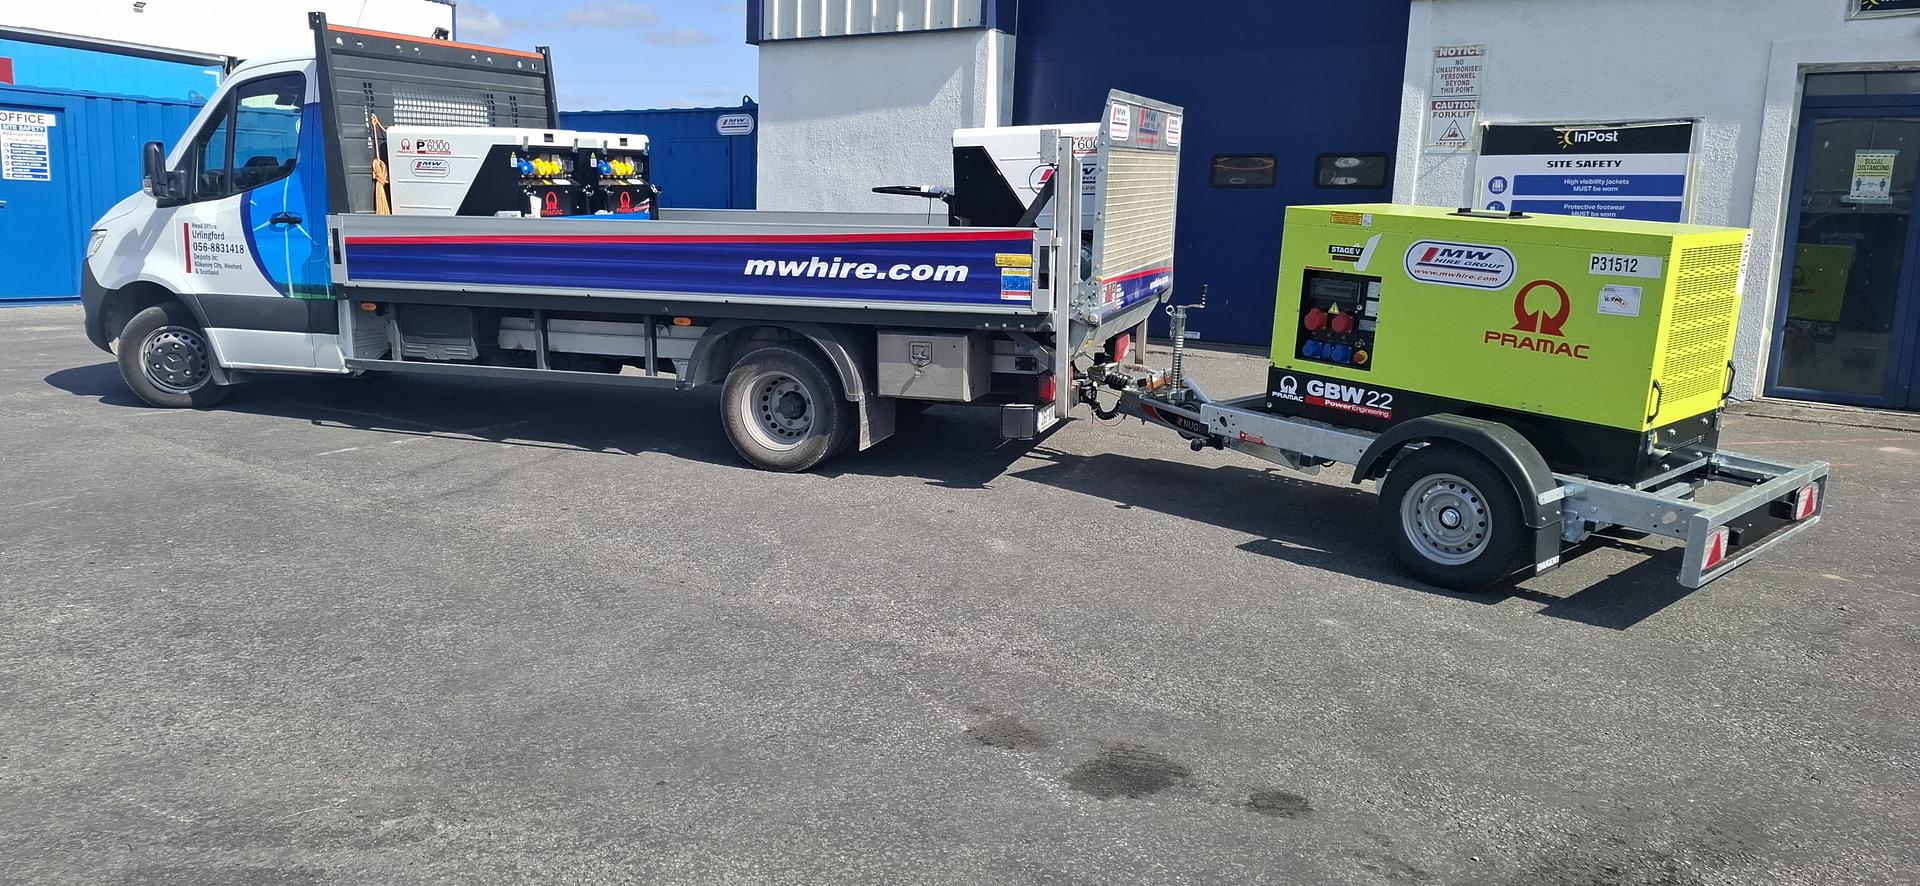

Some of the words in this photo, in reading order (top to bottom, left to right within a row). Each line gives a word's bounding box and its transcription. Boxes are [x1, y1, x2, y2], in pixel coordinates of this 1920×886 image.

[1439, 47, 1482, 57] NOTICE
[1435, 101, 1477, 109] CAUTION
[0, 112, 45, 124] OFFICE
[1574, 131, 1619, 143] InPost
[1547, 160, 1573, 168] SITE
[1575, 160, 1622, 168] SAFETY
[1563, 178, 1578, 186] High
[1579, 178, 1605, 186] visibility
[1563, 203, 1595, 211] Protective
[192, 230, 225, 241] Urlingford
[193, 242, 245, 254] 056-8831418
[1331, 246, 1355, 254] STAGE
[1440, 248, 1494, 260] MW
[194, 253, 211, 261] Depots
[744, 256, 969, 282] mwhire.com
[1464, 261, 1504, 269] GROUP
[1591, 256, 1638, 273] P31512
[1414, 268, 1498, 282] www.mwhire.com
[1484, 330, 1590, 360] PRAMAC
[1272, 391, 1304, 403] PRAMAC
[1306, 379, 1365, 405] GBW
[1365, 390, 1393, 410] 22
[1324, 399, 1389, 418] PowerEngineering
